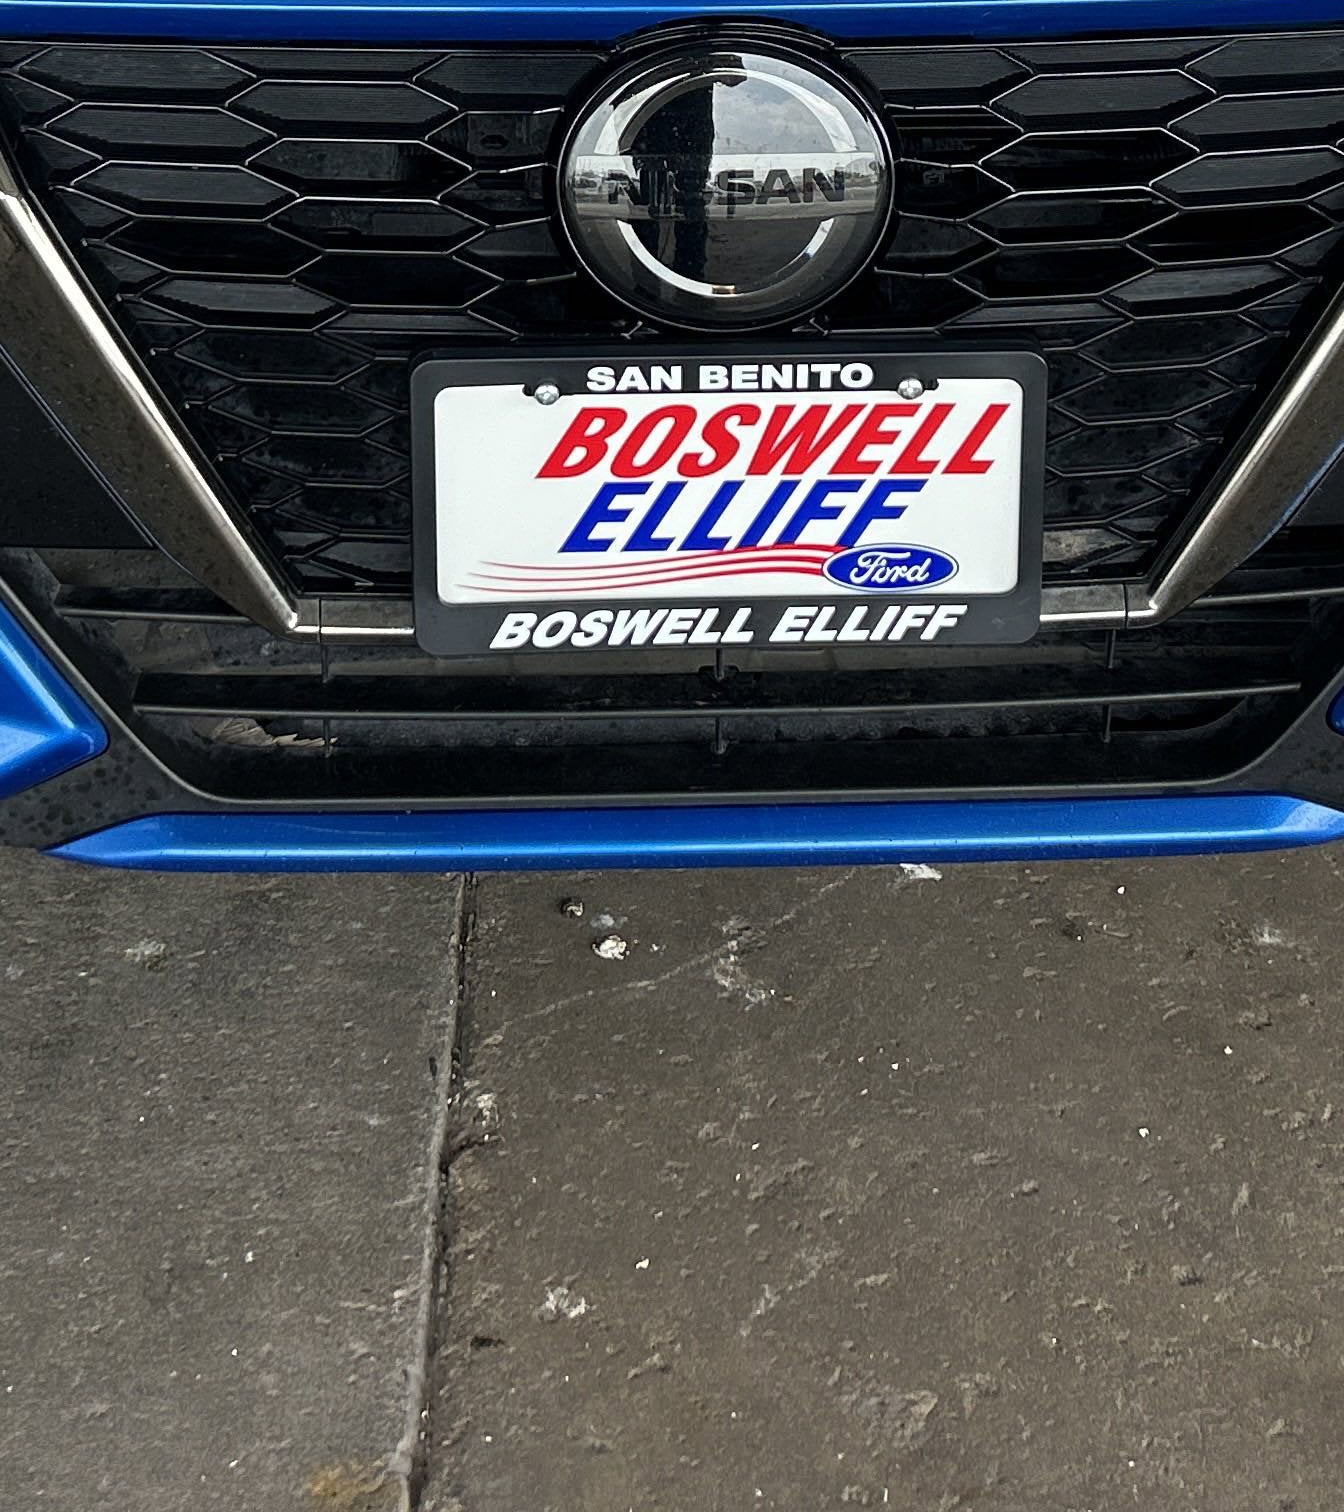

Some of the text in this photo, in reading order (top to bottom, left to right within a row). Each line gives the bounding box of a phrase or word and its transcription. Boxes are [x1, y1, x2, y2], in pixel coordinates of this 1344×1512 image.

[586, 363, 874, 392] SAN BENITO
[536, 403, 1010, 479] BOSWELL
[557, 478, 929, 554] ELLIFF
[849, 550, 930, 586] Ford
[489, 605, 968, 649] BOSWELL ELLIFF
